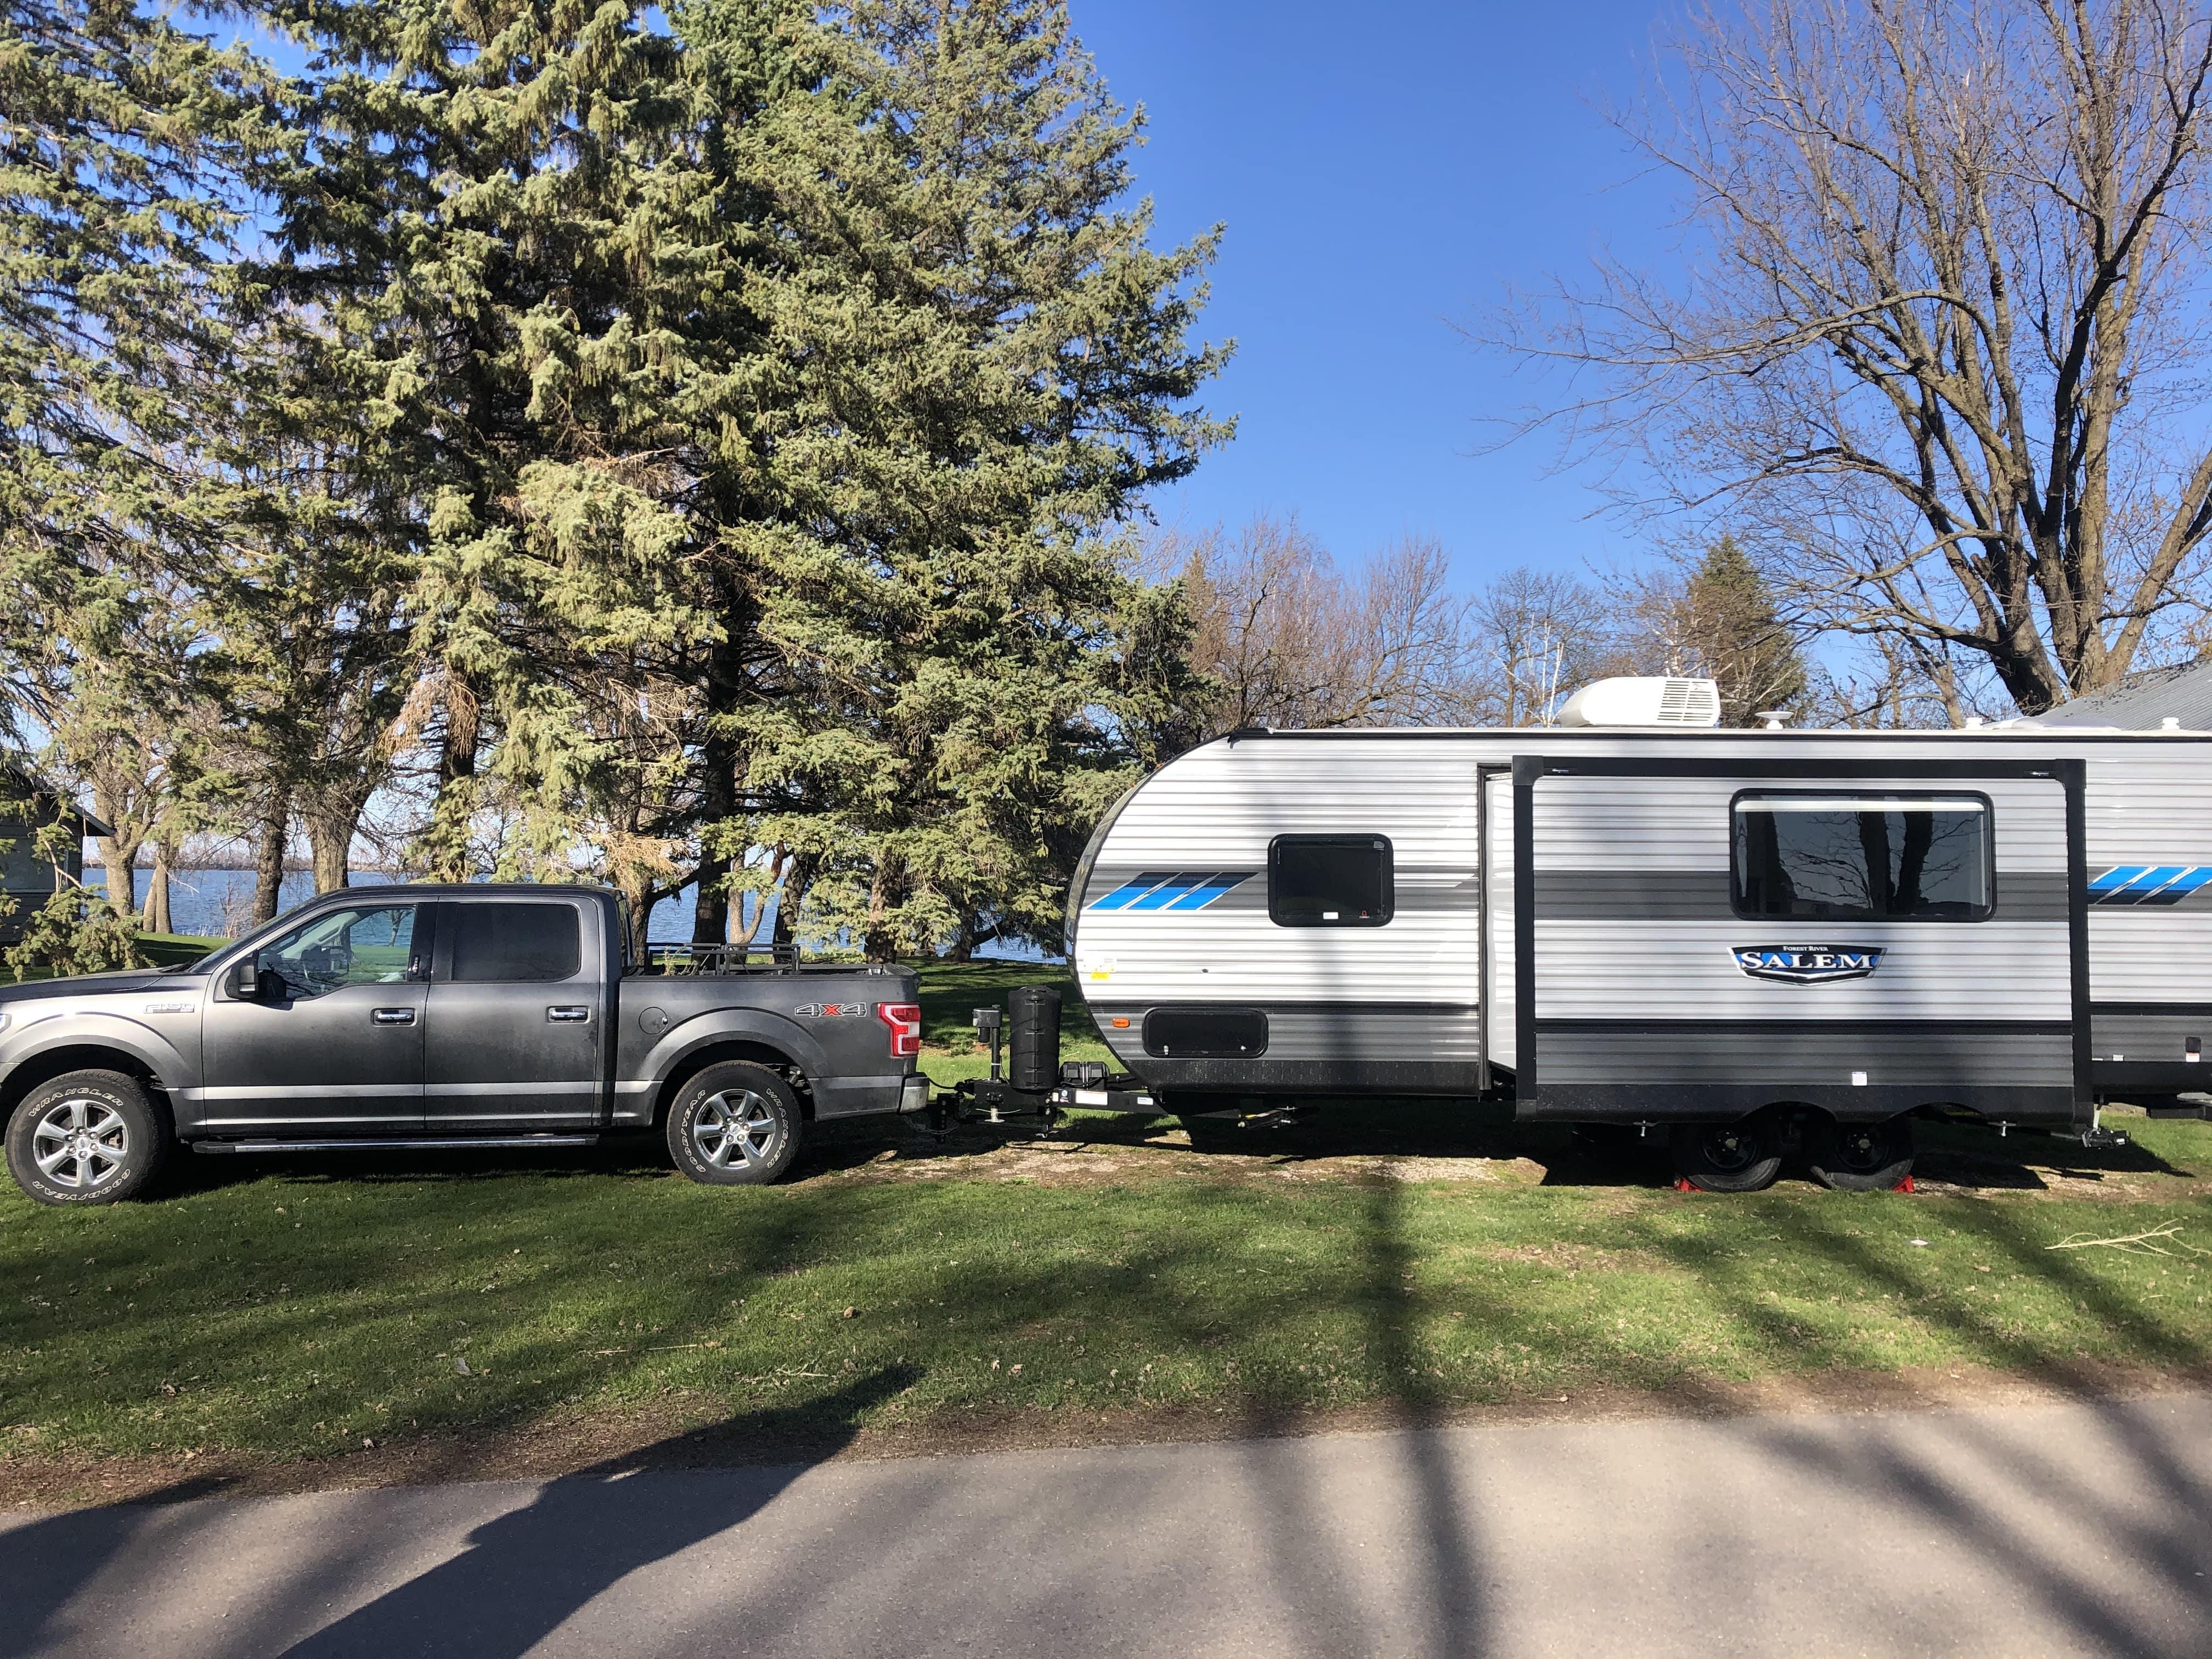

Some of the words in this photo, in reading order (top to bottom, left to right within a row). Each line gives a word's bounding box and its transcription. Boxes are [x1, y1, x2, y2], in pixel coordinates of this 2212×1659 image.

[1741, 952, 1873, 969] SALEM
[28, 1087, 123, 1117] WRANGLER
[766, 1088, 788, 1168] WRANGLER
